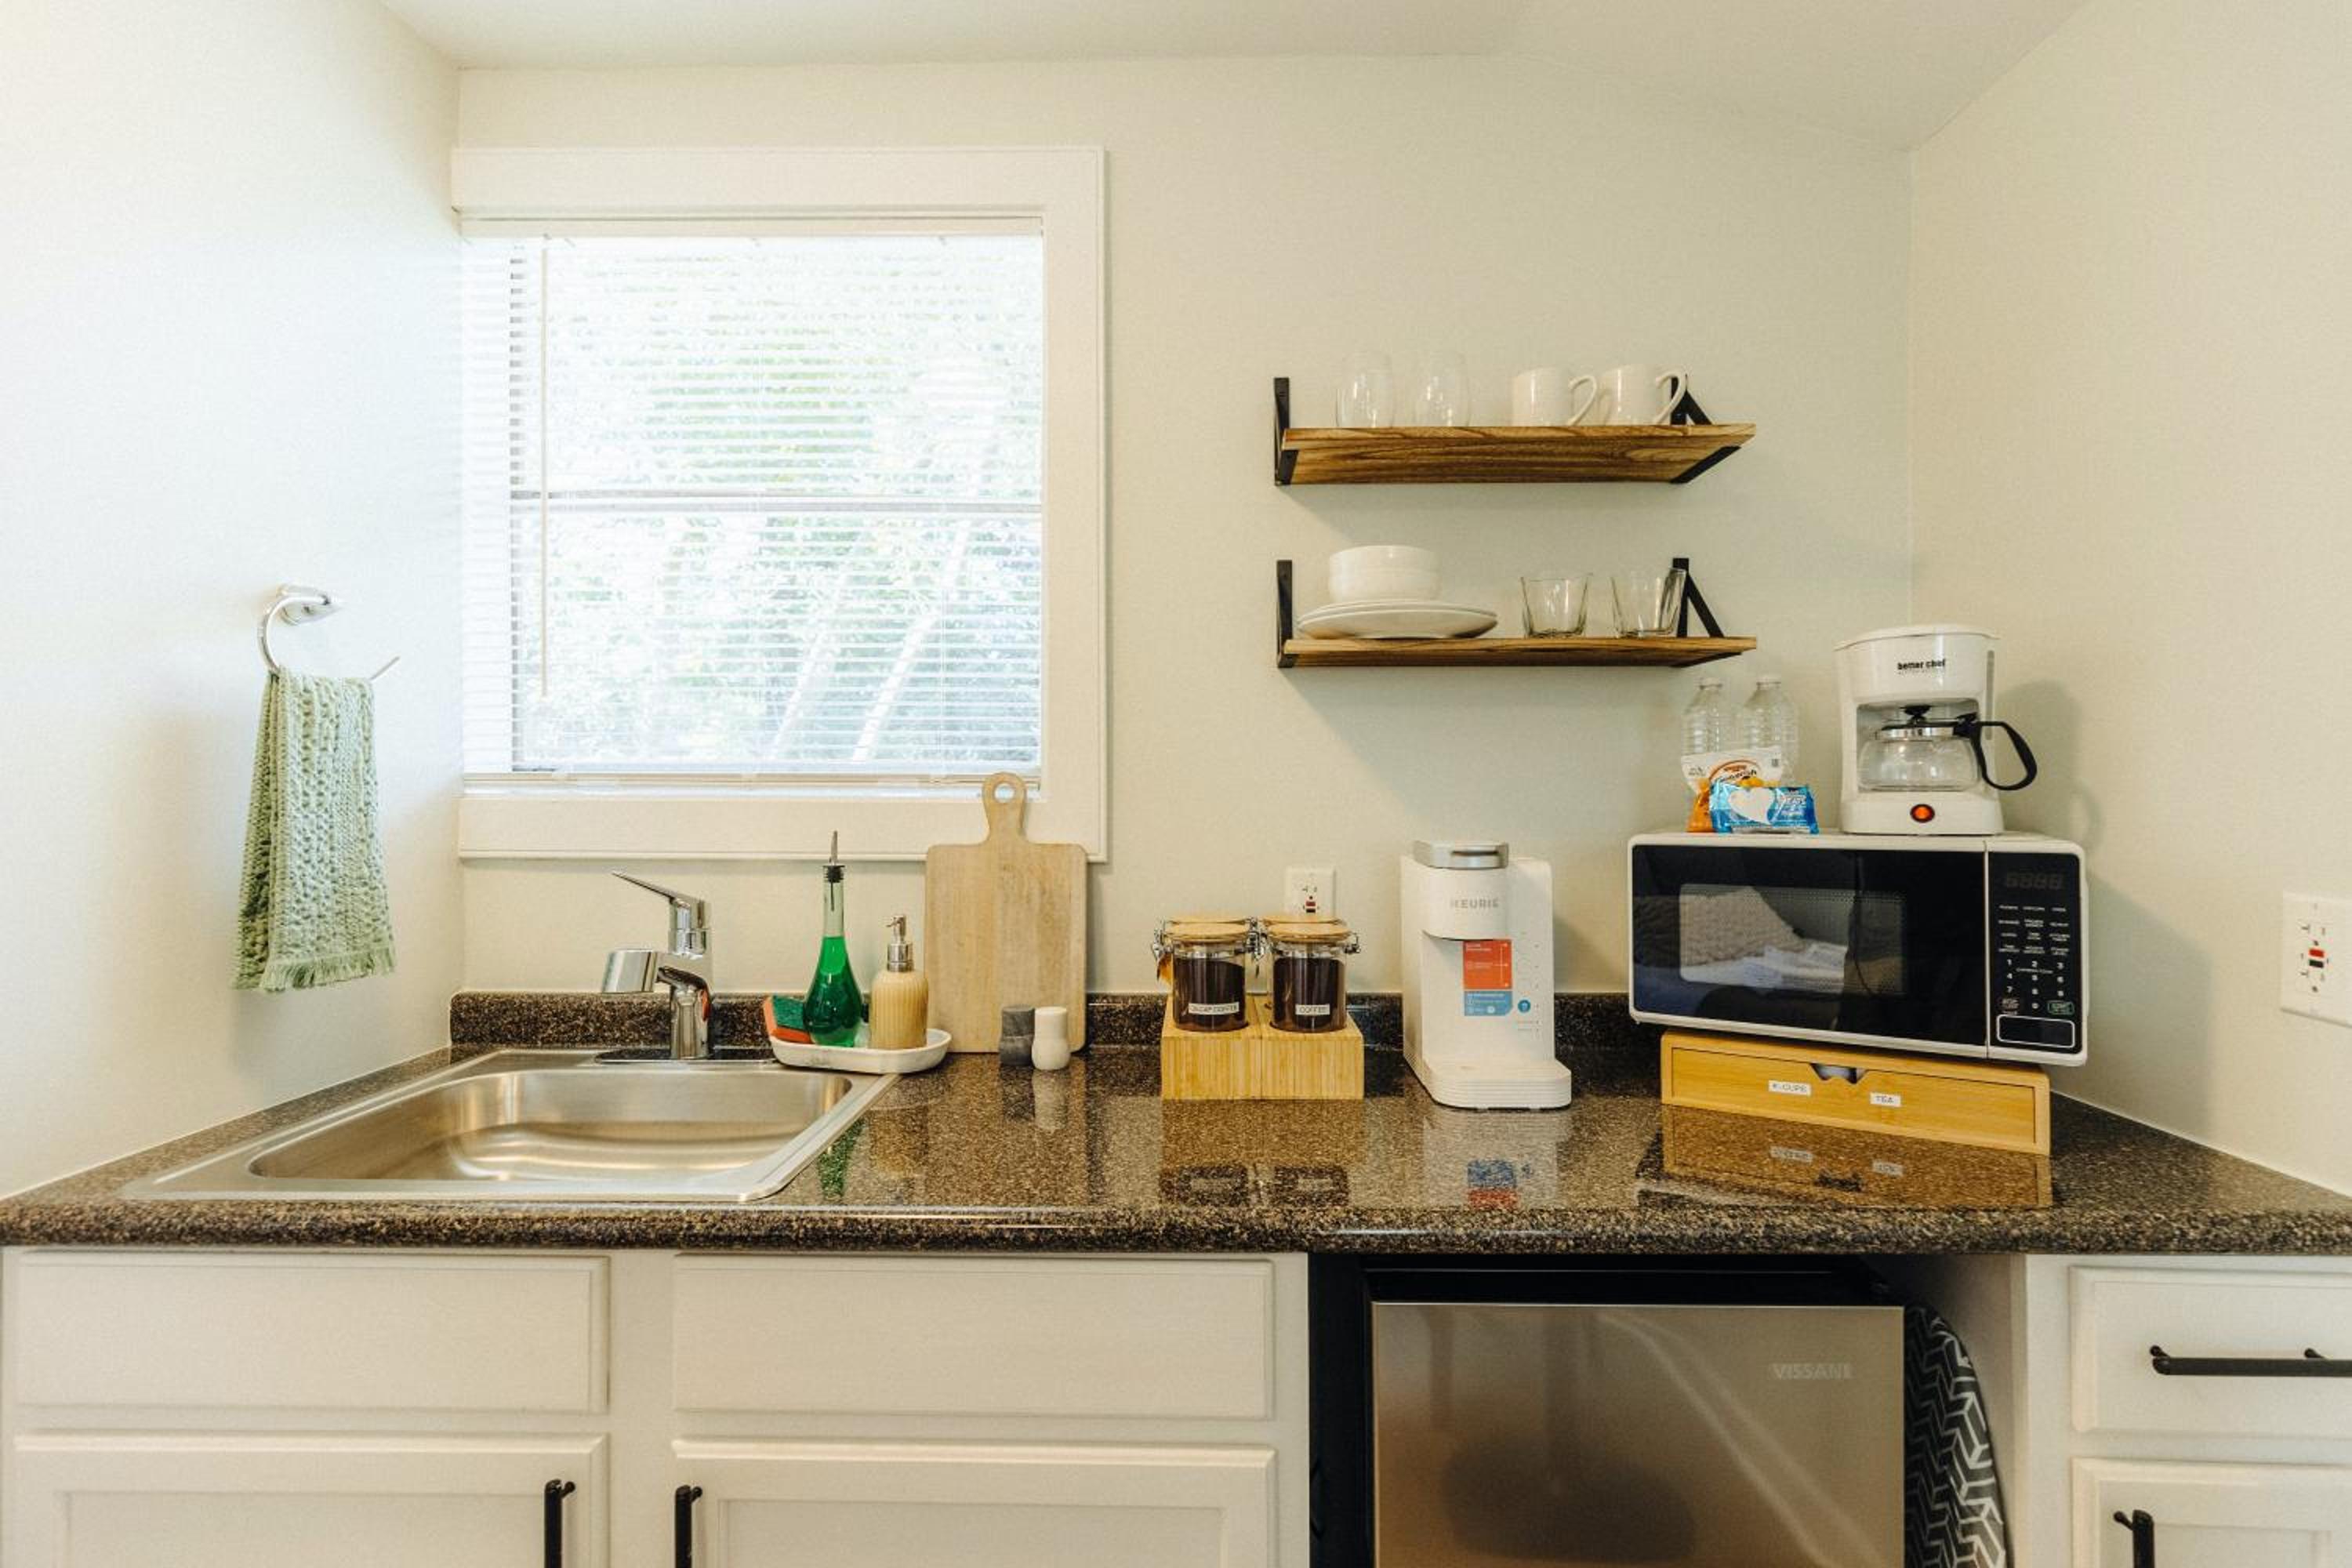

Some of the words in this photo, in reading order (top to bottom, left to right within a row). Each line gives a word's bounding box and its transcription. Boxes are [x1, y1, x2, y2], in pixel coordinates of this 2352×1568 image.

[1897, 662, 1924, 670] better
[1926, 659, 1946, 669] chef
[1875, 1094, 1894, 1104] TEA
[1772, 1364, 1852, 1380] VISSANI
